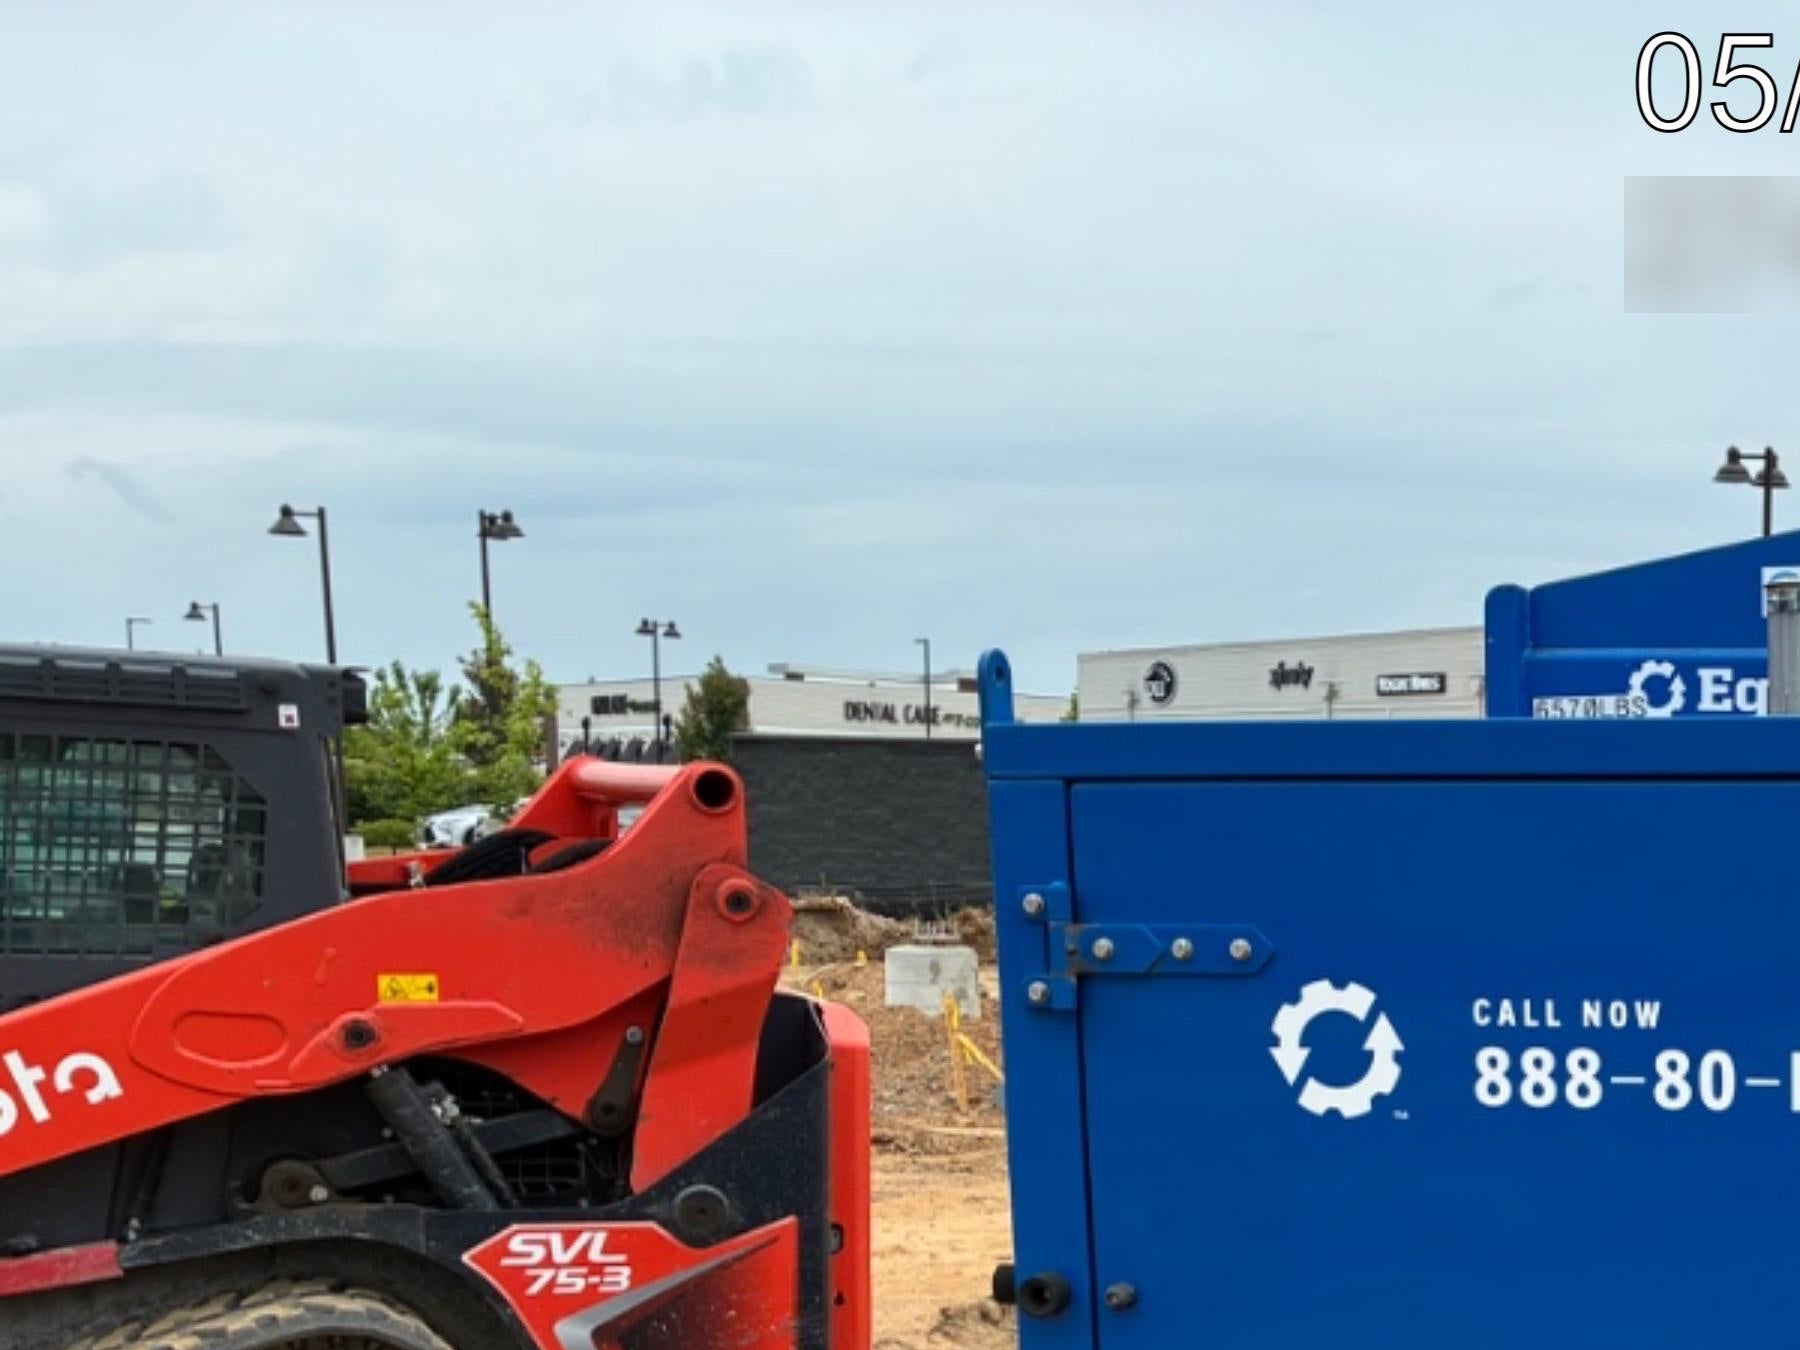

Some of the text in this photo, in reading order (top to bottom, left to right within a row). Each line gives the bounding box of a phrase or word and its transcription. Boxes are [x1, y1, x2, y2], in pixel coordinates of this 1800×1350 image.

[844, 702, 898, 723] DENTAL
[1472, 998, 1661, 1029] CALL NOW
[500, 1231, 628, 1266] SVL
[525, 1266, 631, 1295] 75-3
